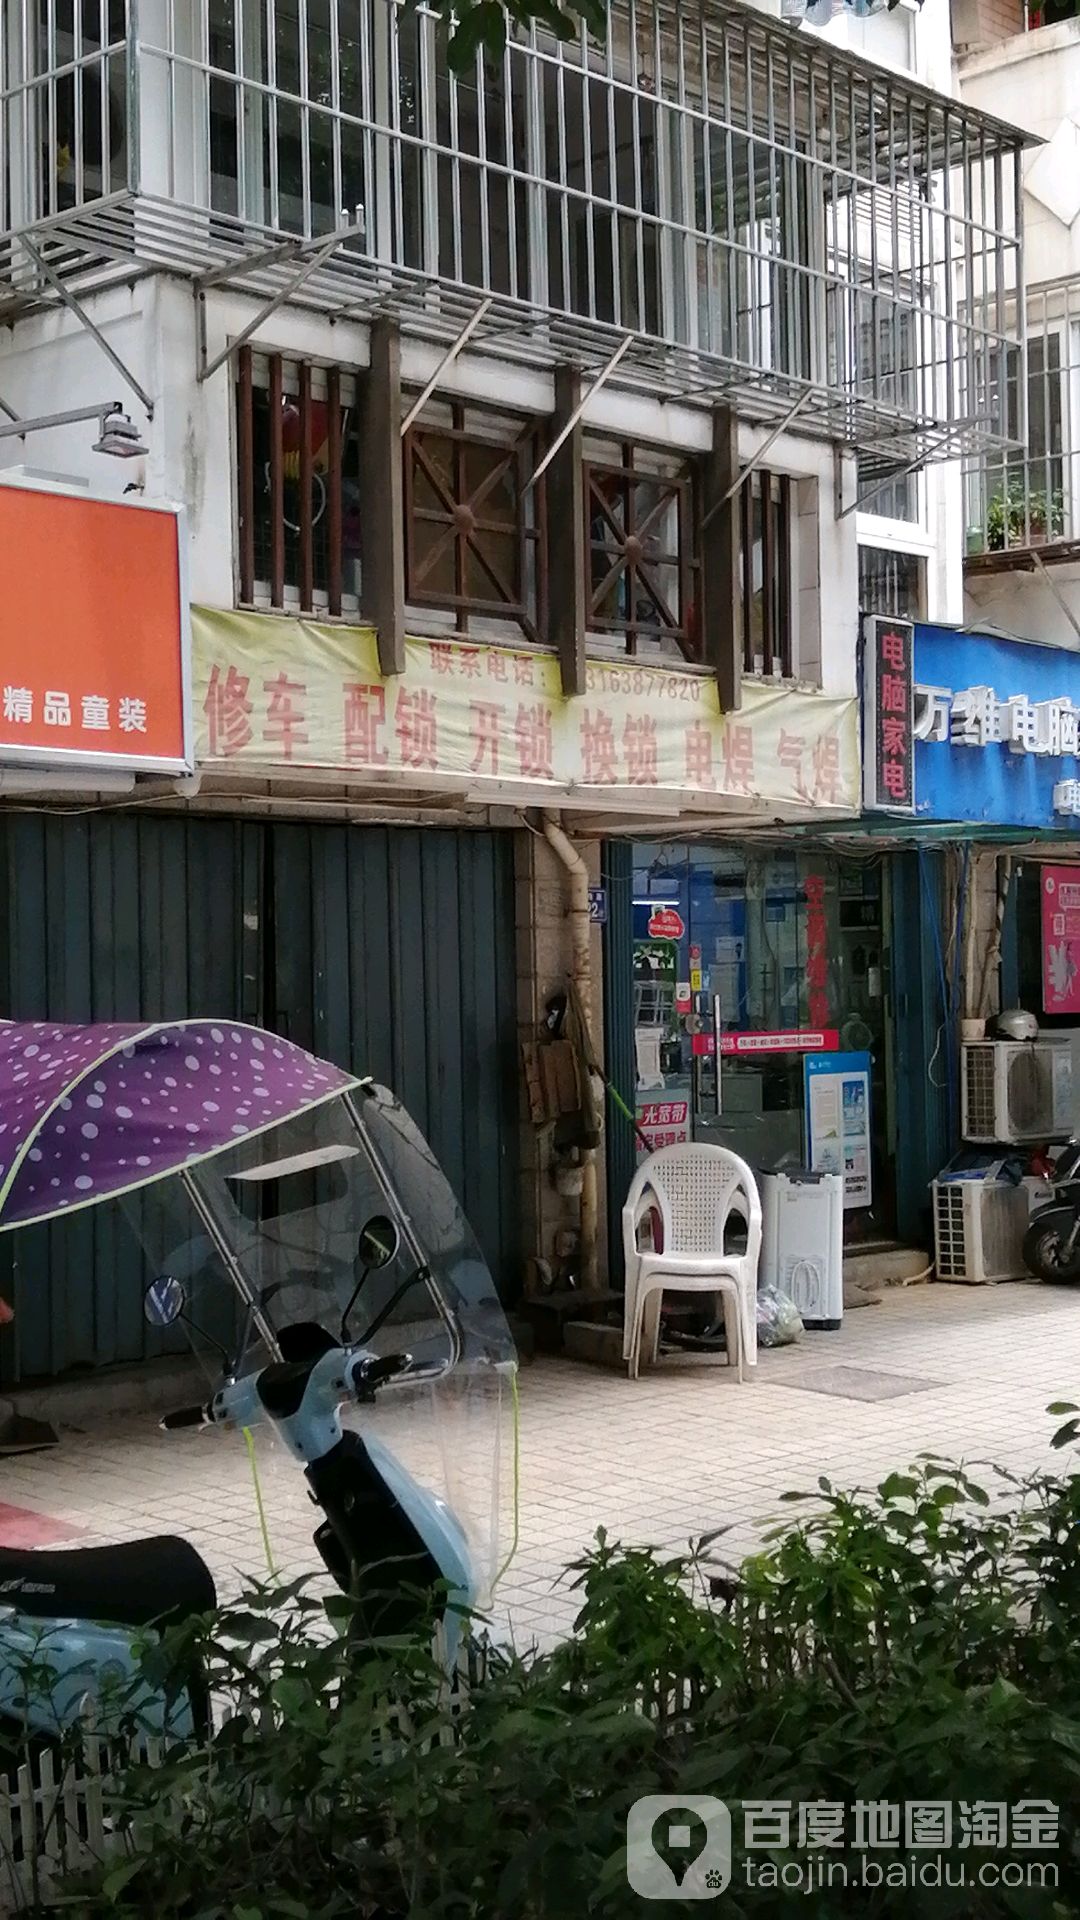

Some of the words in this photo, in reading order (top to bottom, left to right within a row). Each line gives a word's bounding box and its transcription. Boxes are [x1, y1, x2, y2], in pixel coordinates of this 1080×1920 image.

[428, 641, 546, 687] 联系电话:
[586, 667, 700, 702] 3163877820
[3, 685, 147, 733] 精品童装
[203, 663, 308, 760] 修车
[343, 682, 439, 770] 配锁
[468, 700, 554, 780] 开锁
[580, 708, 658, 785] 换锁
[685, 720, 755, 796] 电焊
[777, 728, 843, 804] 气焊
[881, 632, 907, 798] 电脑家电
[914, 684, 1080, 756] 万维电脑
